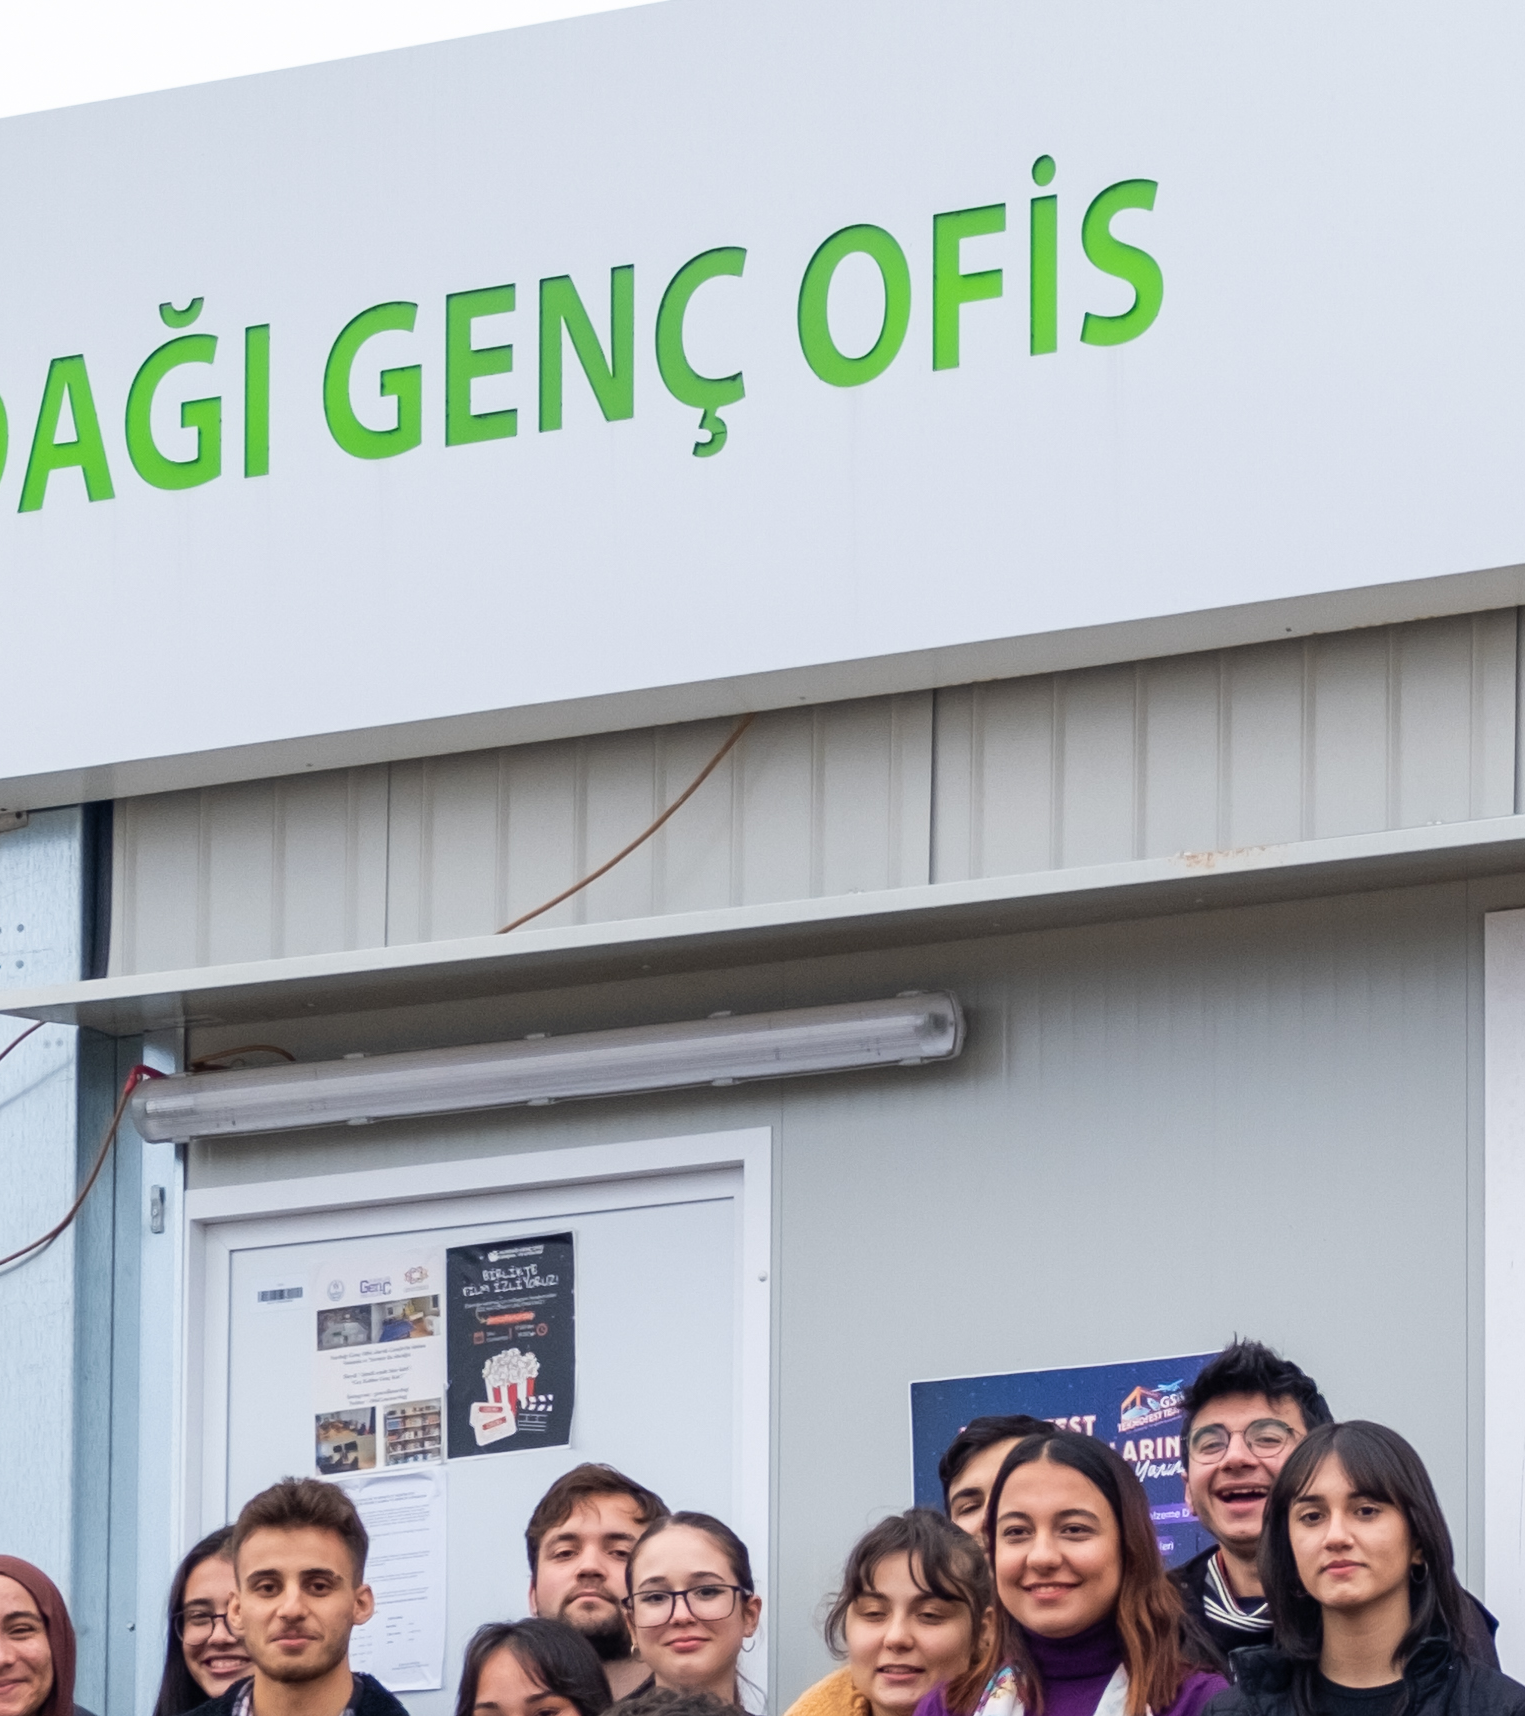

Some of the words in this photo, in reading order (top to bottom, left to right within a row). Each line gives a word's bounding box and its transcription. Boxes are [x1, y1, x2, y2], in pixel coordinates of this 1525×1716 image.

[323, 247, 746, 457] GENÇ
[798, 155, 1165, 388] OFİS
[1122, 1434, 1182, 1461] ARIN
